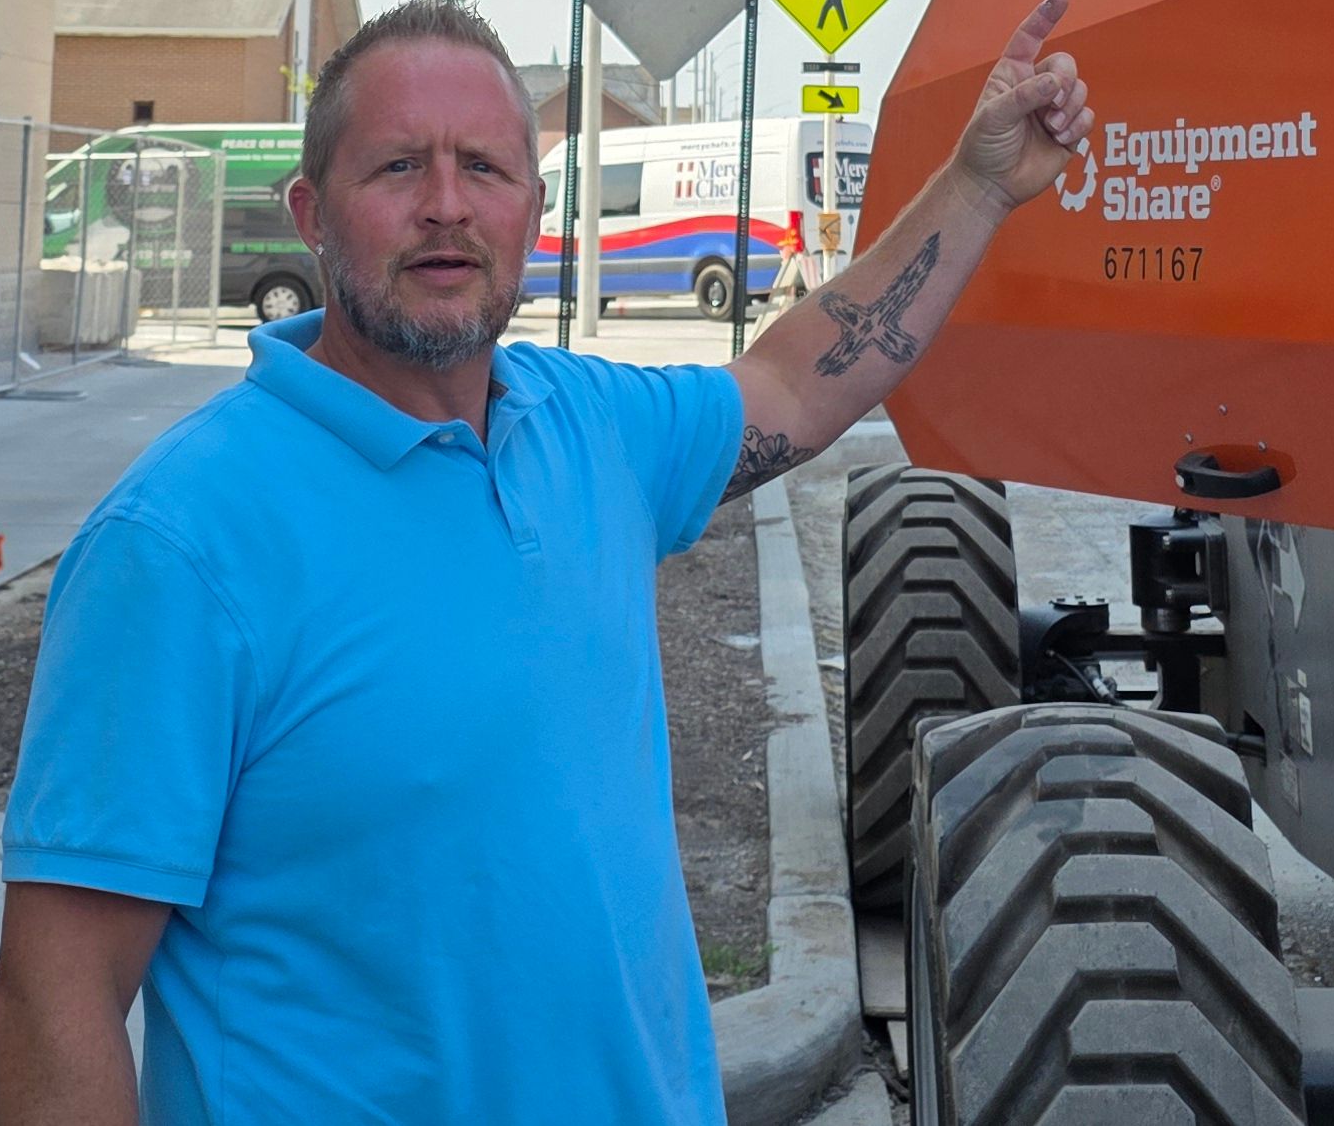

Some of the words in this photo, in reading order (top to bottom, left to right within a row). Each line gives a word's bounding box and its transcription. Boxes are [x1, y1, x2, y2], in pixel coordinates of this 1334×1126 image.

[1103, 111, 1317, 175] Equipment
[695, 178, 740, 198] Chef
[1104, 246, 1203, 282] 671167
